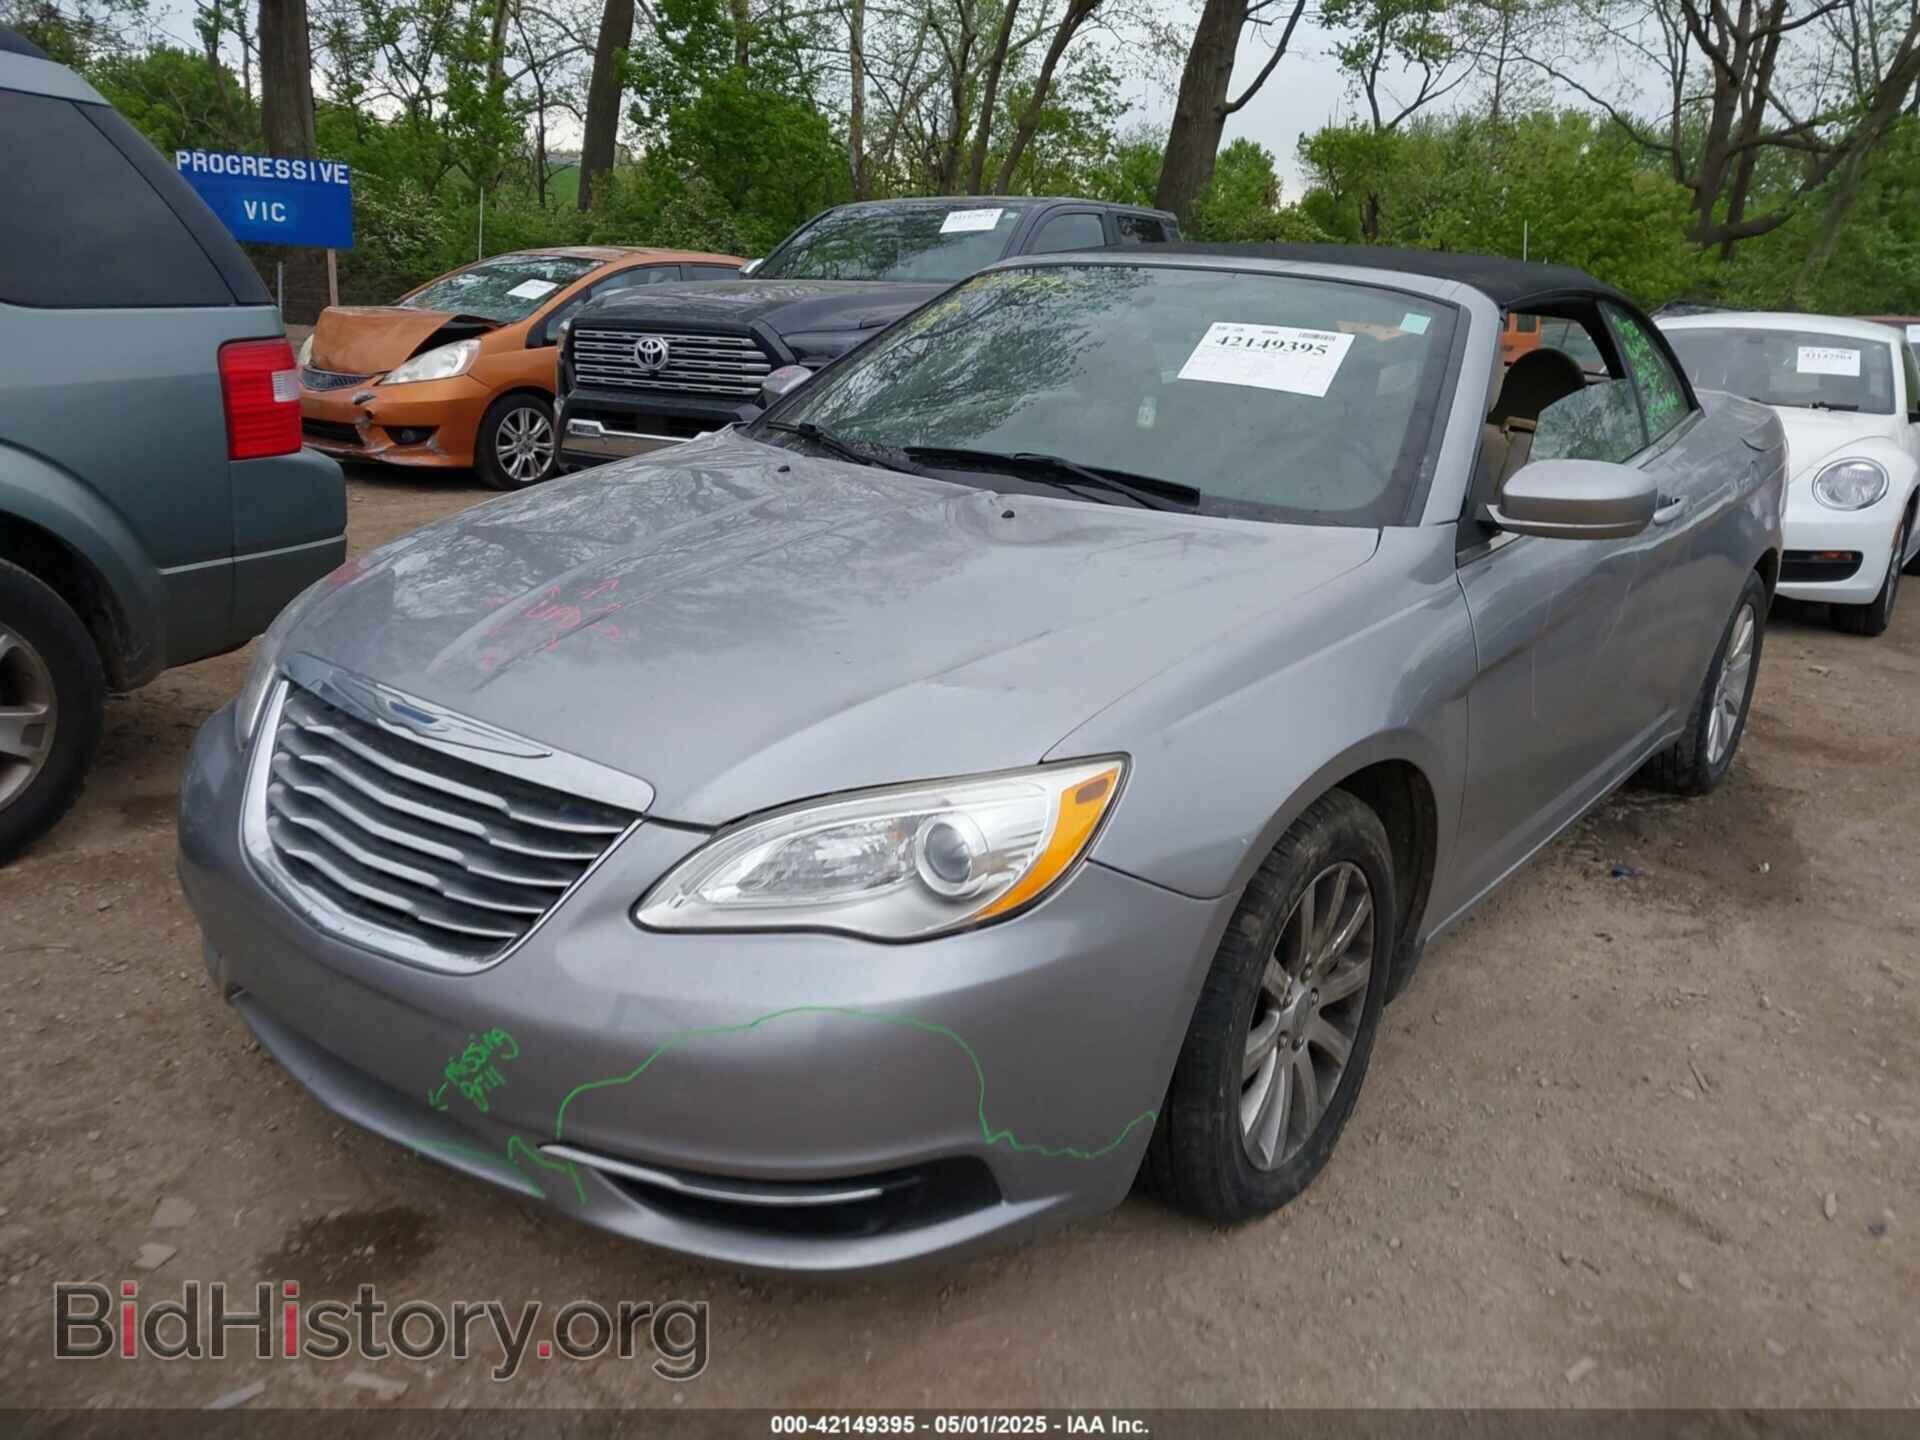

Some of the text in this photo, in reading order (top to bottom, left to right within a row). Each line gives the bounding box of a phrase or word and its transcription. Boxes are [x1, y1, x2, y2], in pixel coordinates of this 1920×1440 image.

[175, 150, 348, 184] PROGRESSIVE
[243, 200, 286, 222] VIC
[1216, 336, 1328, 355] 42149395
